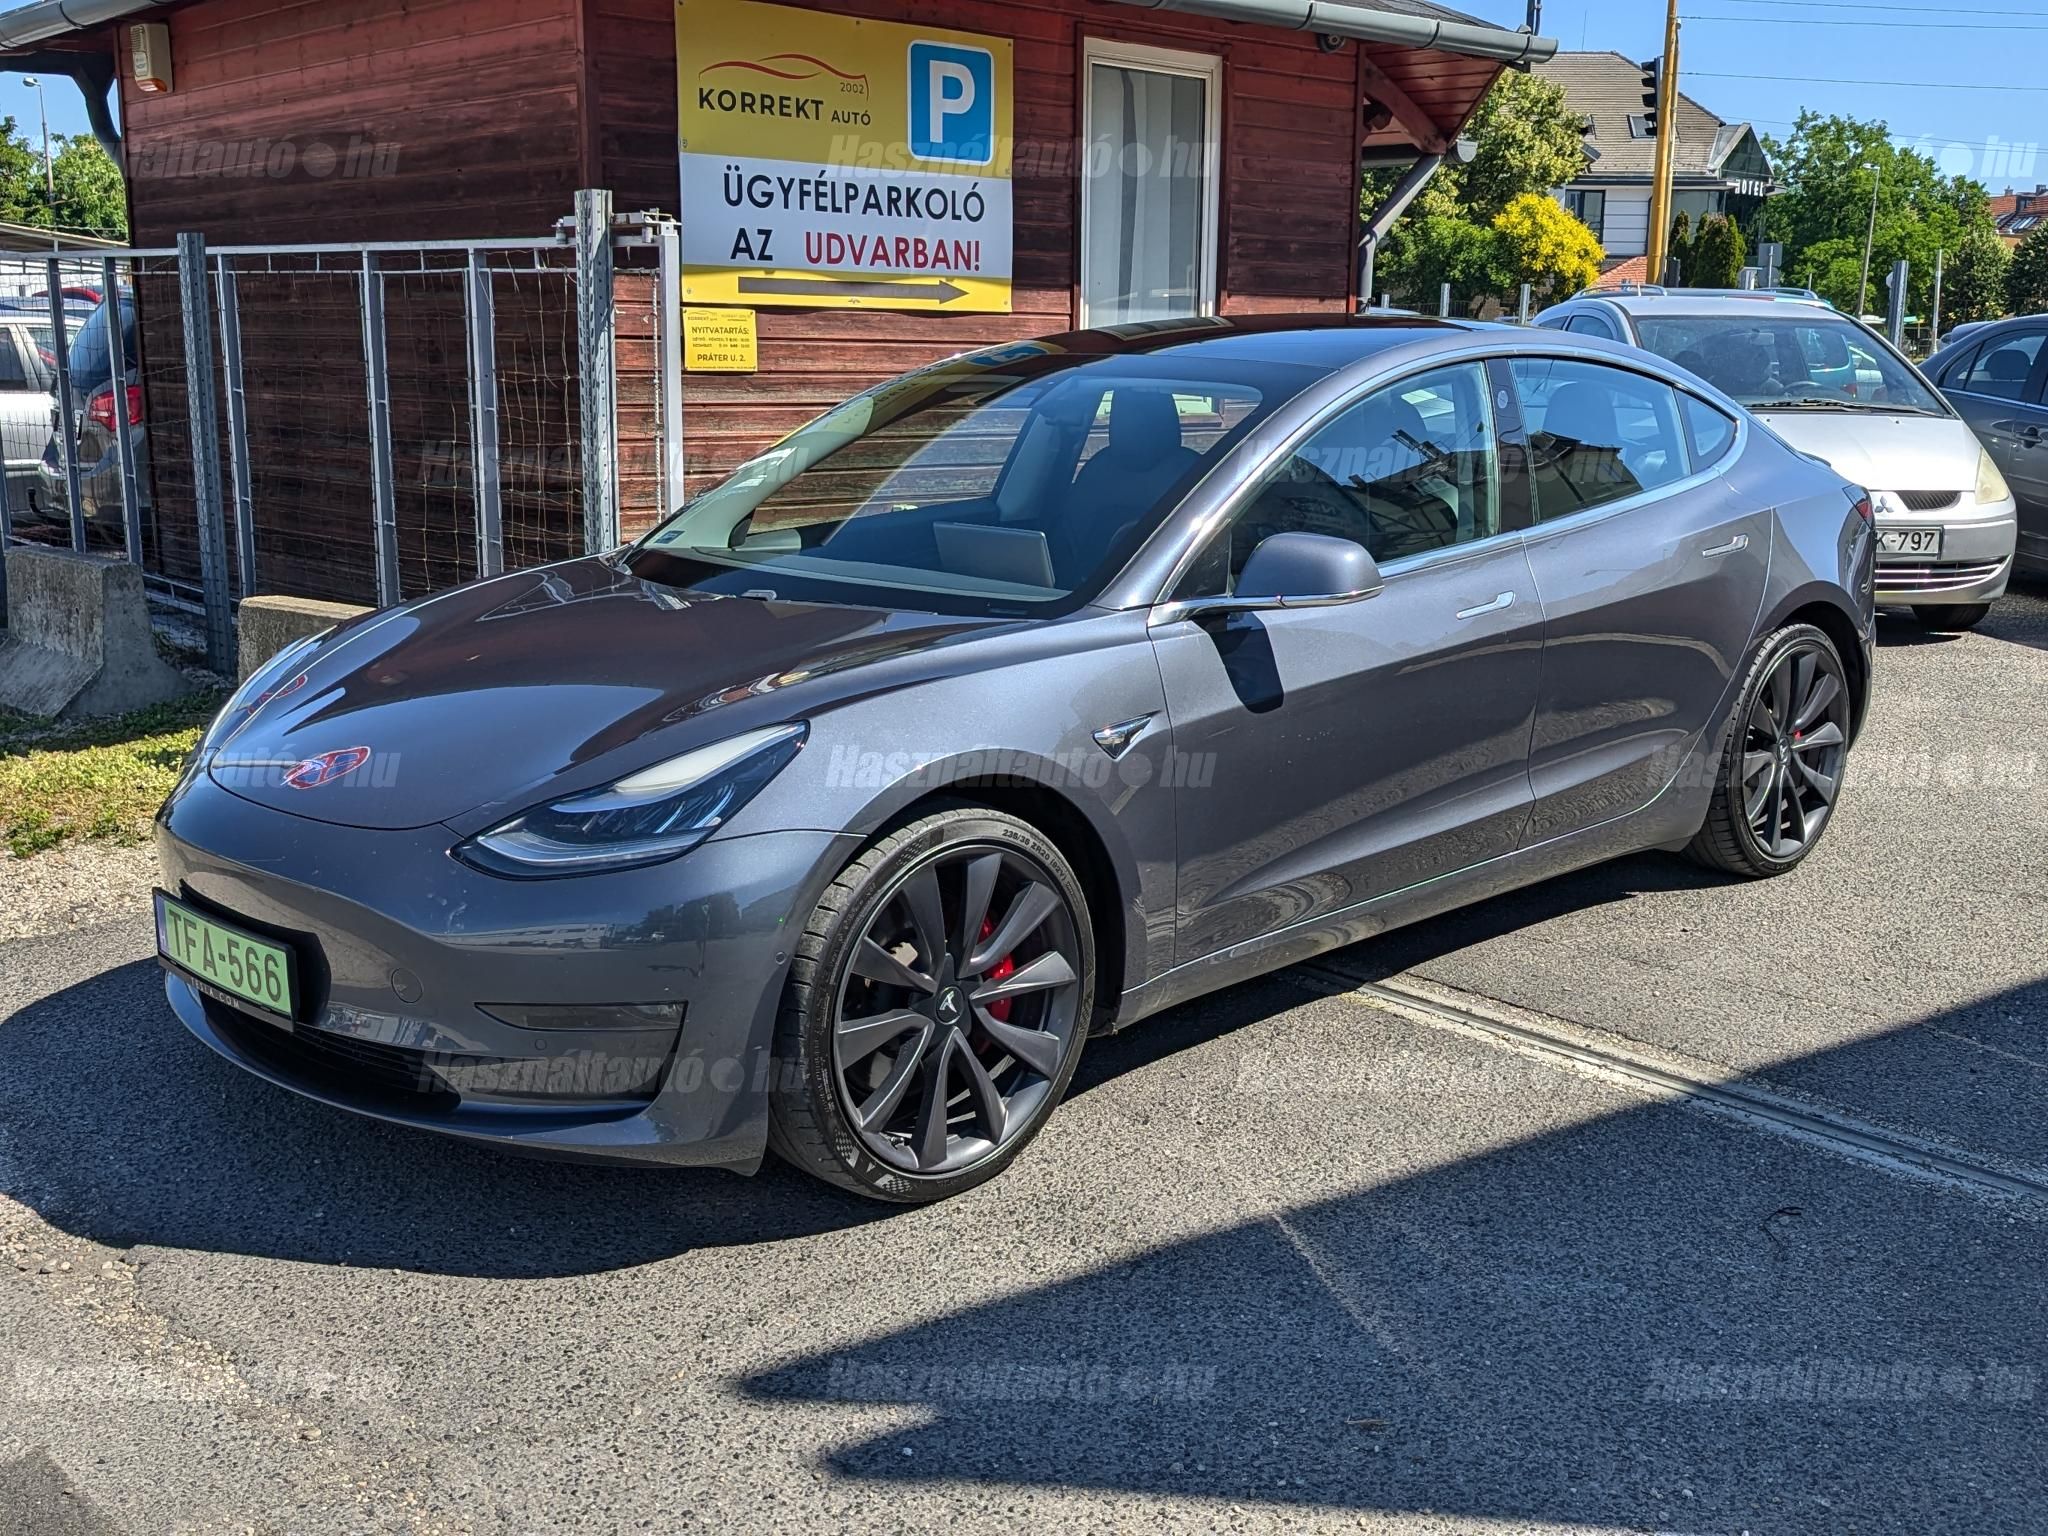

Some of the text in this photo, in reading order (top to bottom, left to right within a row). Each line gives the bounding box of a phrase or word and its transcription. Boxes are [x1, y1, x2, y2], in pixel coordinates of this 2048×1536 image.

[698, 87, 871, 126] KORREKT AUTÓ
[840, 81, 865, 95] 2002
[929, 59, 976, 144] P
[723, 164, 985, 223] ÜGYFÉLPARKOLÓ
[730, 227, 981, 272] AZ UDVARBAN!
[691, 325, 750, 335] NYITVATARTÁS:
[697, 352, 729, 362] PRÁTER
[730, 354, 738, 362] U.
[168, 908, 282, 1004] TFA-566
